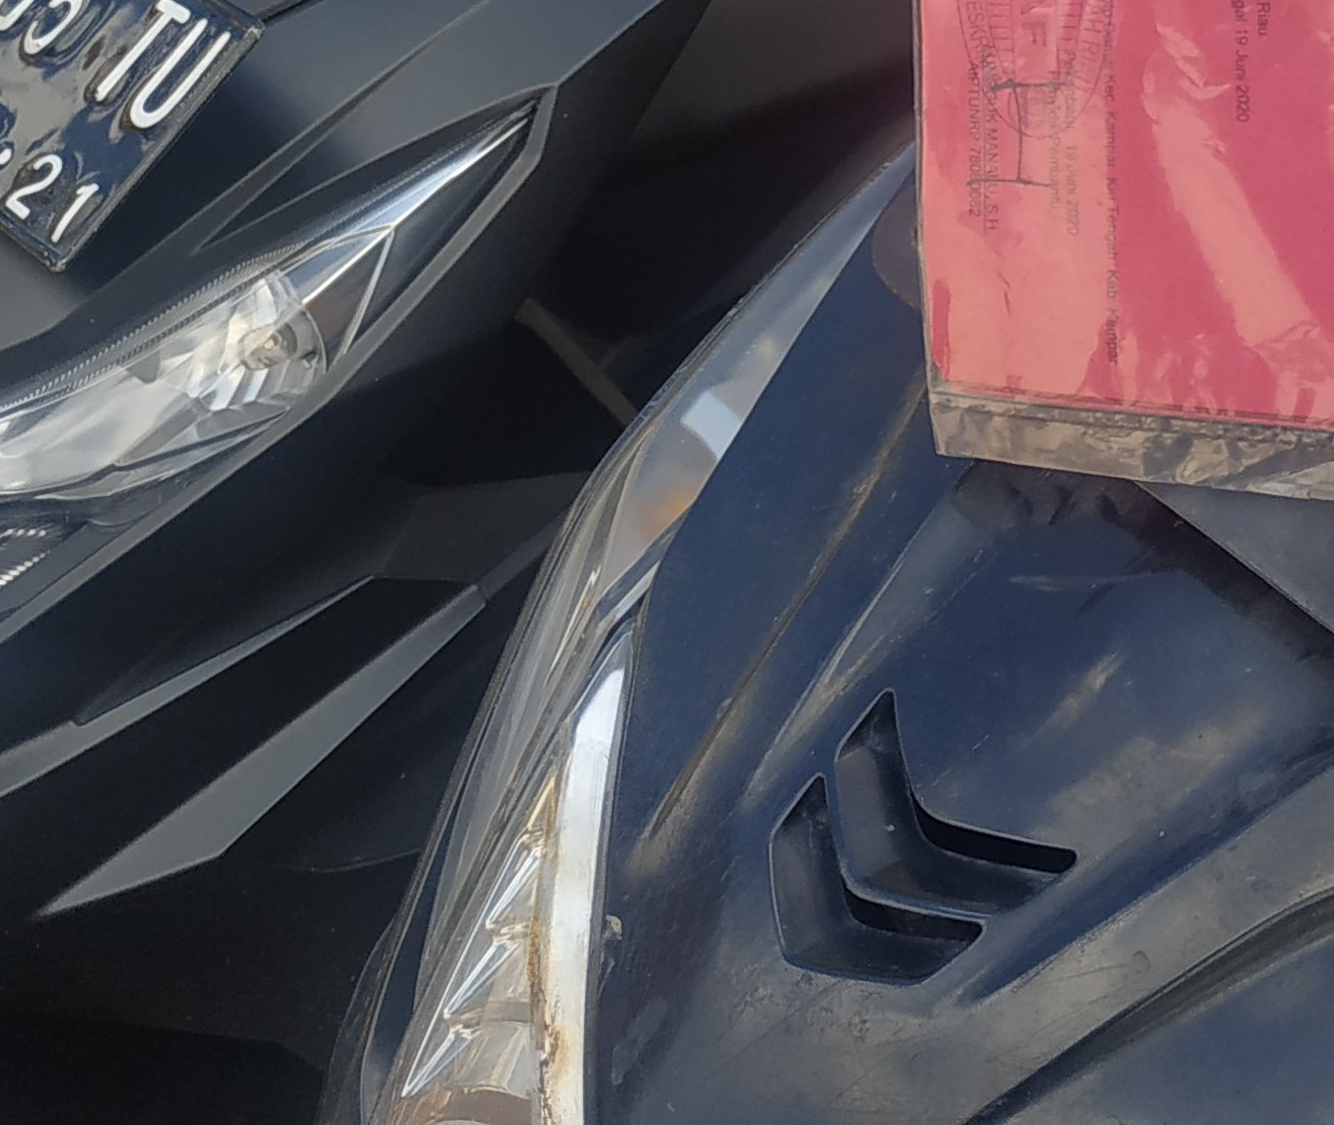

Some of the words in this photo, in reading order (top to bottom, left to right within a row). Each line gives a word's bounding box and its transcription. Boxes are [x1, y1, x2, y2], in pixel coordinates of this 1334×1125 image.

[1233, 28, 1249, 46] 19
[1255, 1, 1271, 38] Riau
[1233, 85, 1250, 123] 2020
[1102, 110, 1116, 170] Kampar
[1064, 200, 1079, 237] 2020
